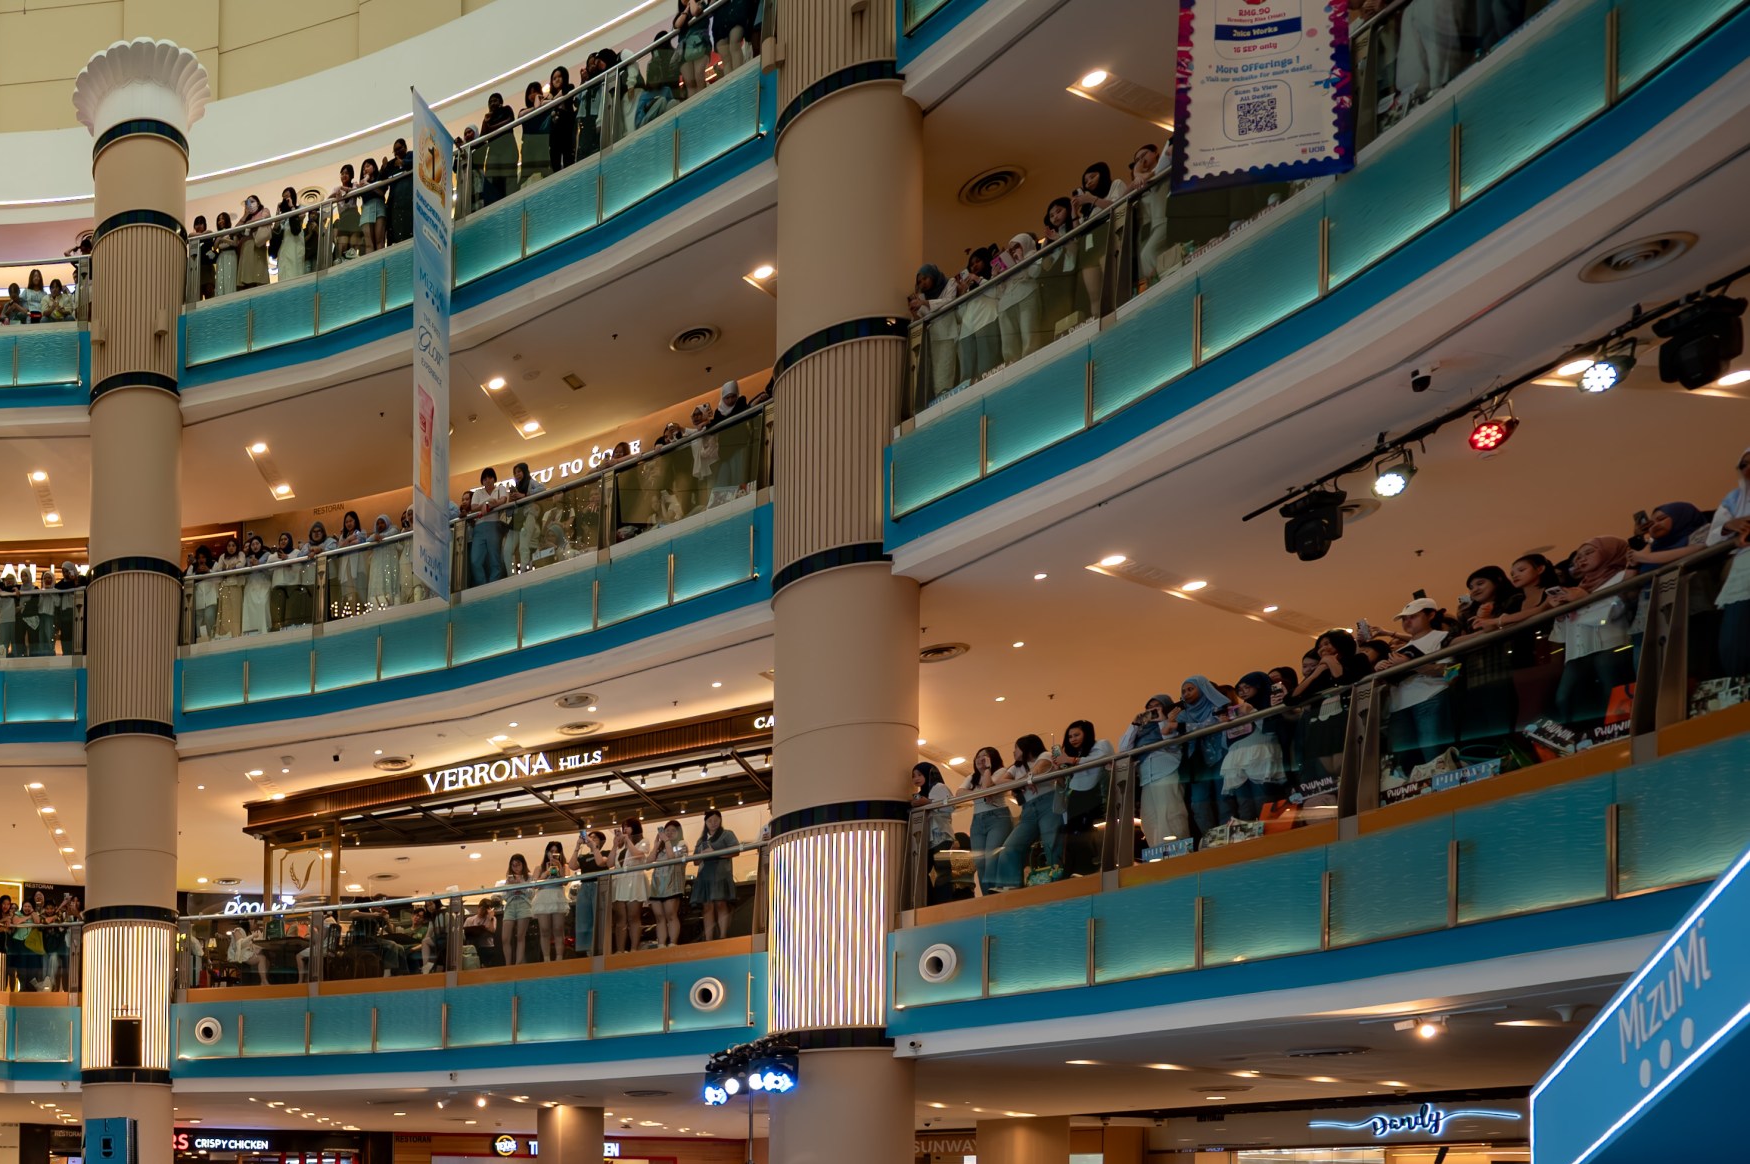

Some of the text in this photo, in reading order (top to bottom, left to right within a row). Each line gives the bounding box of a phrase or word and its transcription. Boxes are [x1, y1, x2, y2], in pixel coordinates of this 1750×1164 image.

[1252, 26, 1278, 35] Works
[1243, 45, 1258, 53] SEP
[1215, 64, 1239, 74] More
[559, 458, 584, 479] TO
[313, 502, 345, 516] RESTORAN
[423, 750, 603, 794] VERRONA HILLS
[1618, 917, 1712, 1065] MizuMi
[1371, 1103, 1444, 1137] Dandy
[195, 1138, 228, 1150] CRISPY
[228, 1139, 269, 1150] CHICKEN
